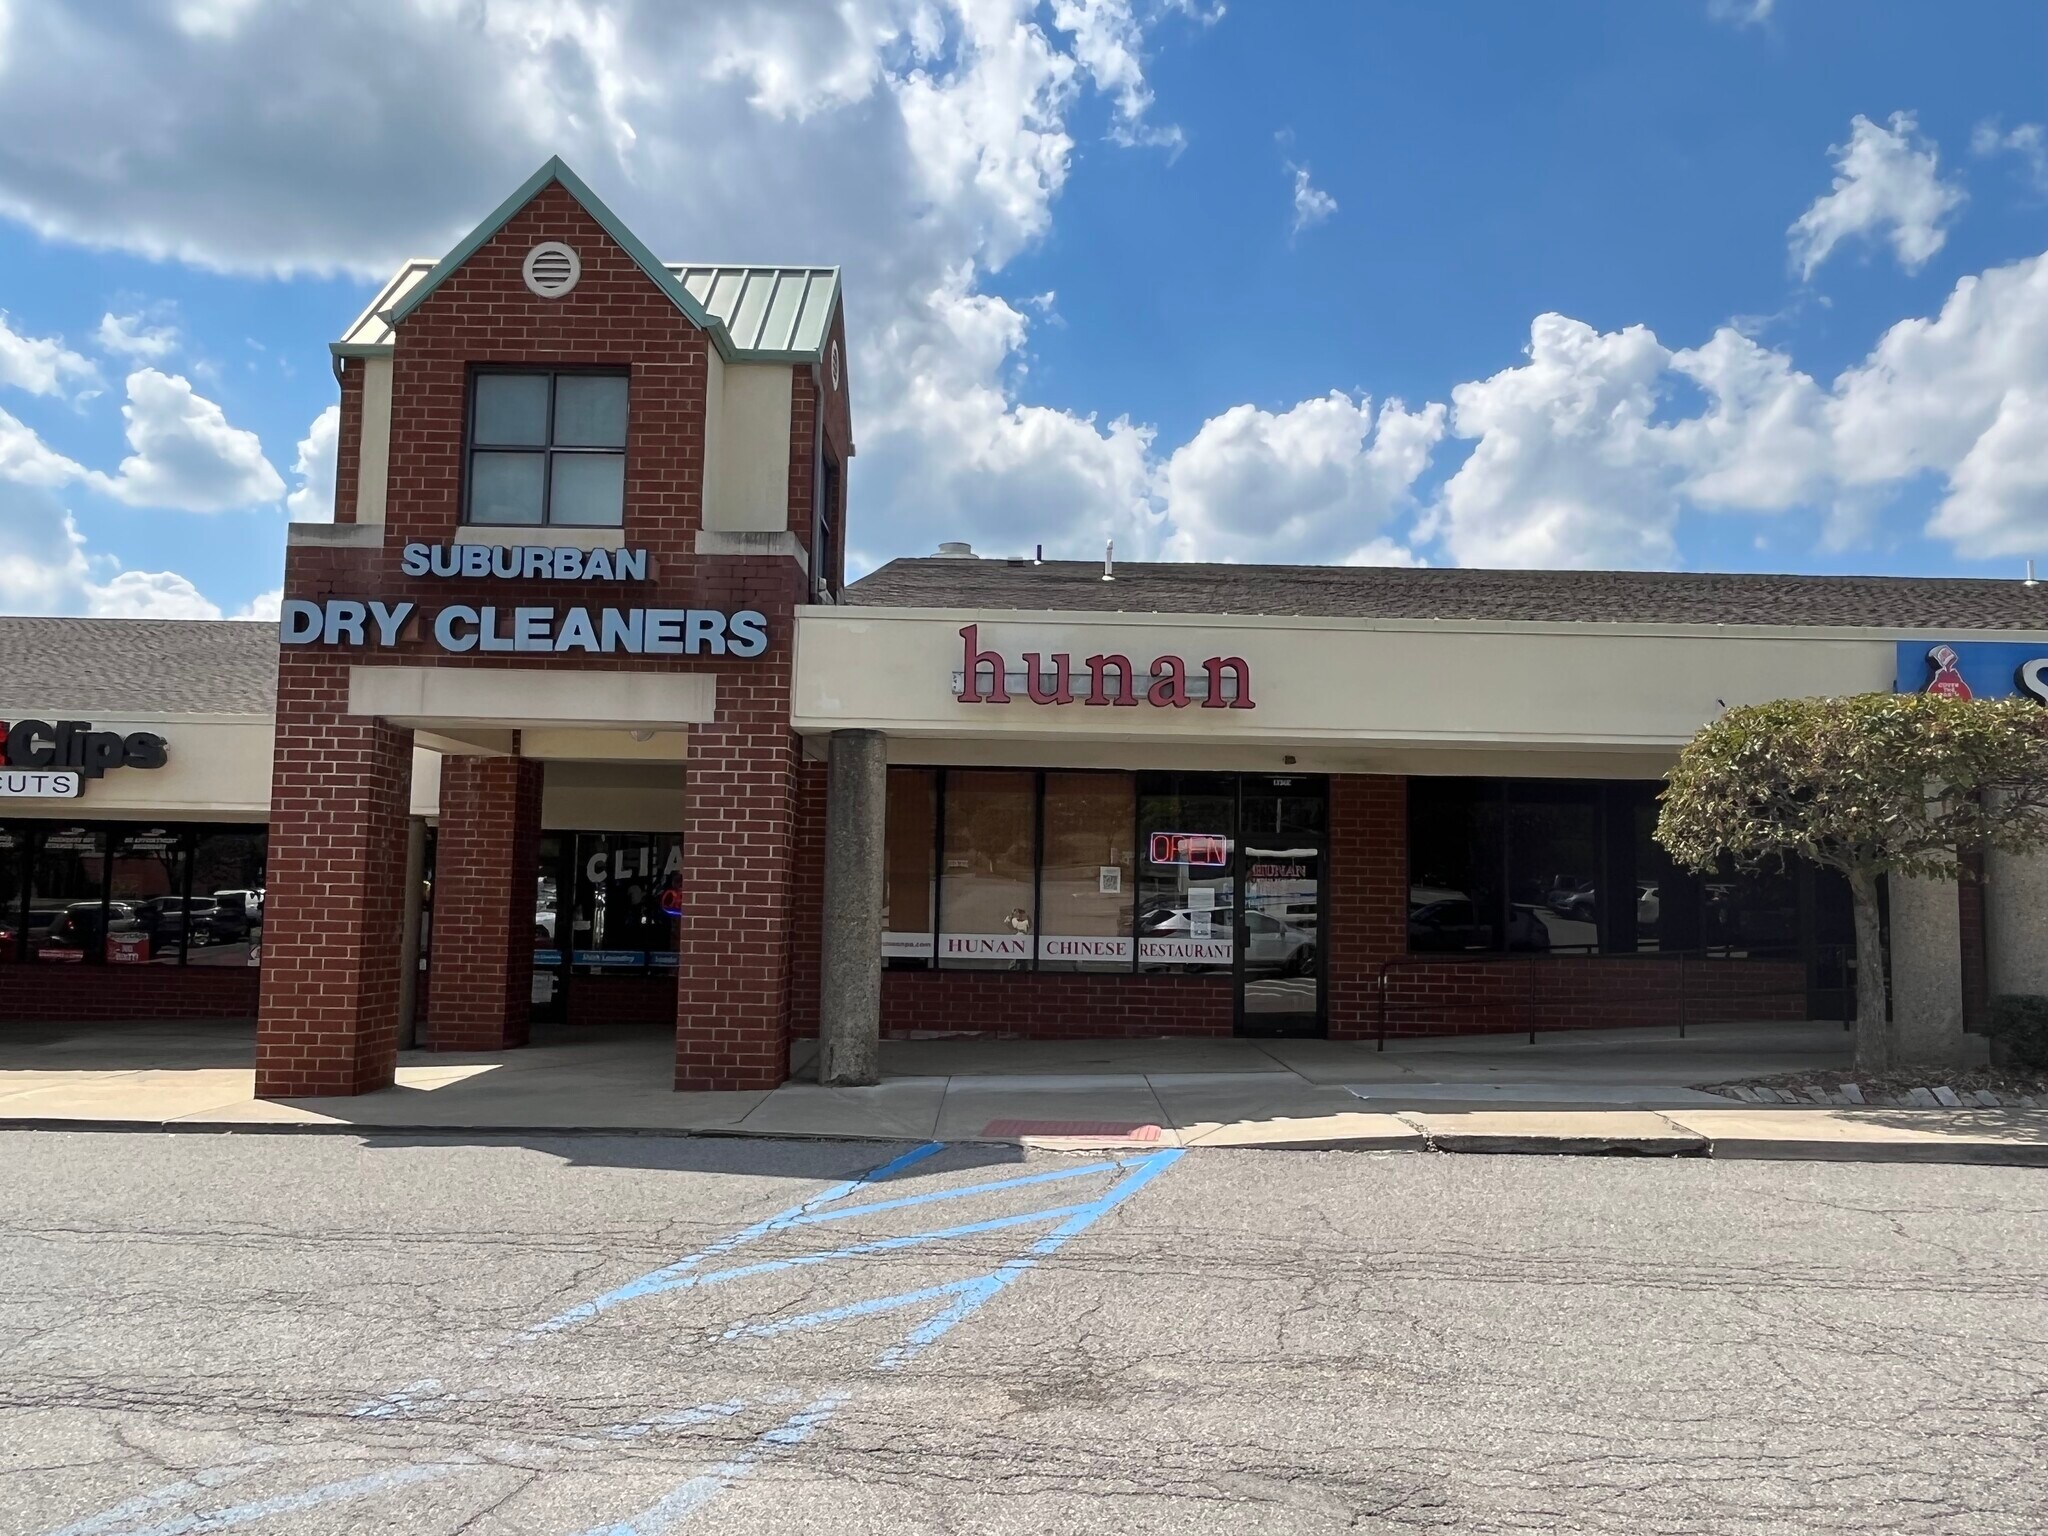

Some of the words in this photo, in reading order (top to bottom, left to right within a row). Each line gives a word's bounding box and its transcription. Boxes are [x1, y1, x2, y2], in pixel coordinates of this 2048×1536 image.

[401, 542, 648, 581] SUBURBAN
[279, 599, 415, 648] DRY
[433, 603, 769, 658] CLEANERS
[957, 623, 1256, 709] hunan
[6, 719, 168, 778] Clips
[0, 775, 71, 793] UTS
[1153, 835, 1225, 864] OPEN
[1252, 864, 1306, 877] HUNAN
[948, 938, 1026, 954] HUNAN
[1046, 940, 1127, 956] CHINESE
[1139, 943, 1233, 958] RESTAURANT
